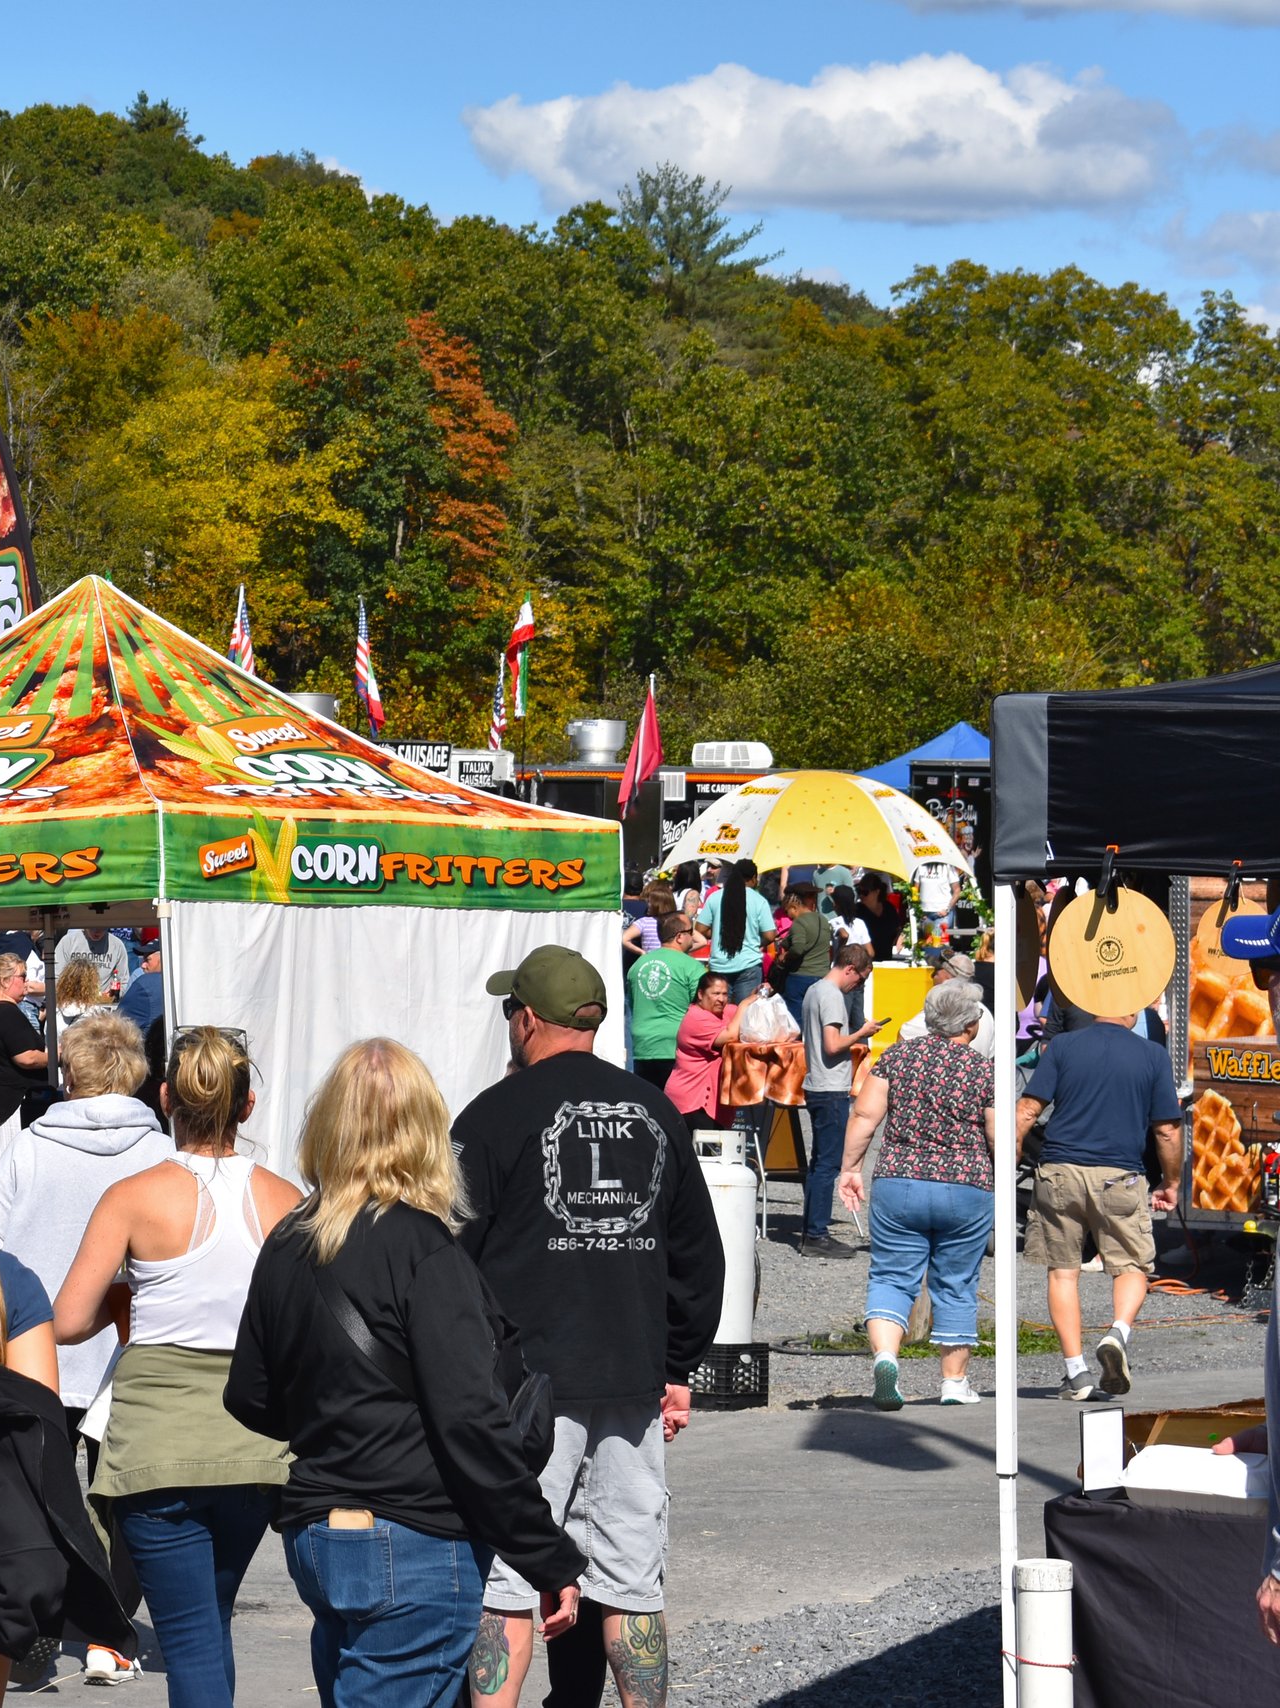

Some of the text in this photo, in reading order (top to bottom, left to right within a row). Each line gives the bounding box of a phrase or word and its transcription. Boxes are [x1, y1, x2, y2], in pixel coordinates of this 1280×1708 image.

[227, 722, 307, 752] Sweet
[397, 744, 448, 768] SAUSAGE
[462, 761, 490, 773] ITALIAN
[233, 754, 397, 790] CORN
[204, 783, 472, 807] FRITTERS
[696, 783, 709, 794] THE
[951, 799, 978, 825] Belly
[202, 842, 586, 890] Sweet CORN FRITTERS
[577, 1121, 634, 1139] LINK
[589, 1142, 623, 1189] L
[547, 1237, 656, 1251] 856-742-130
